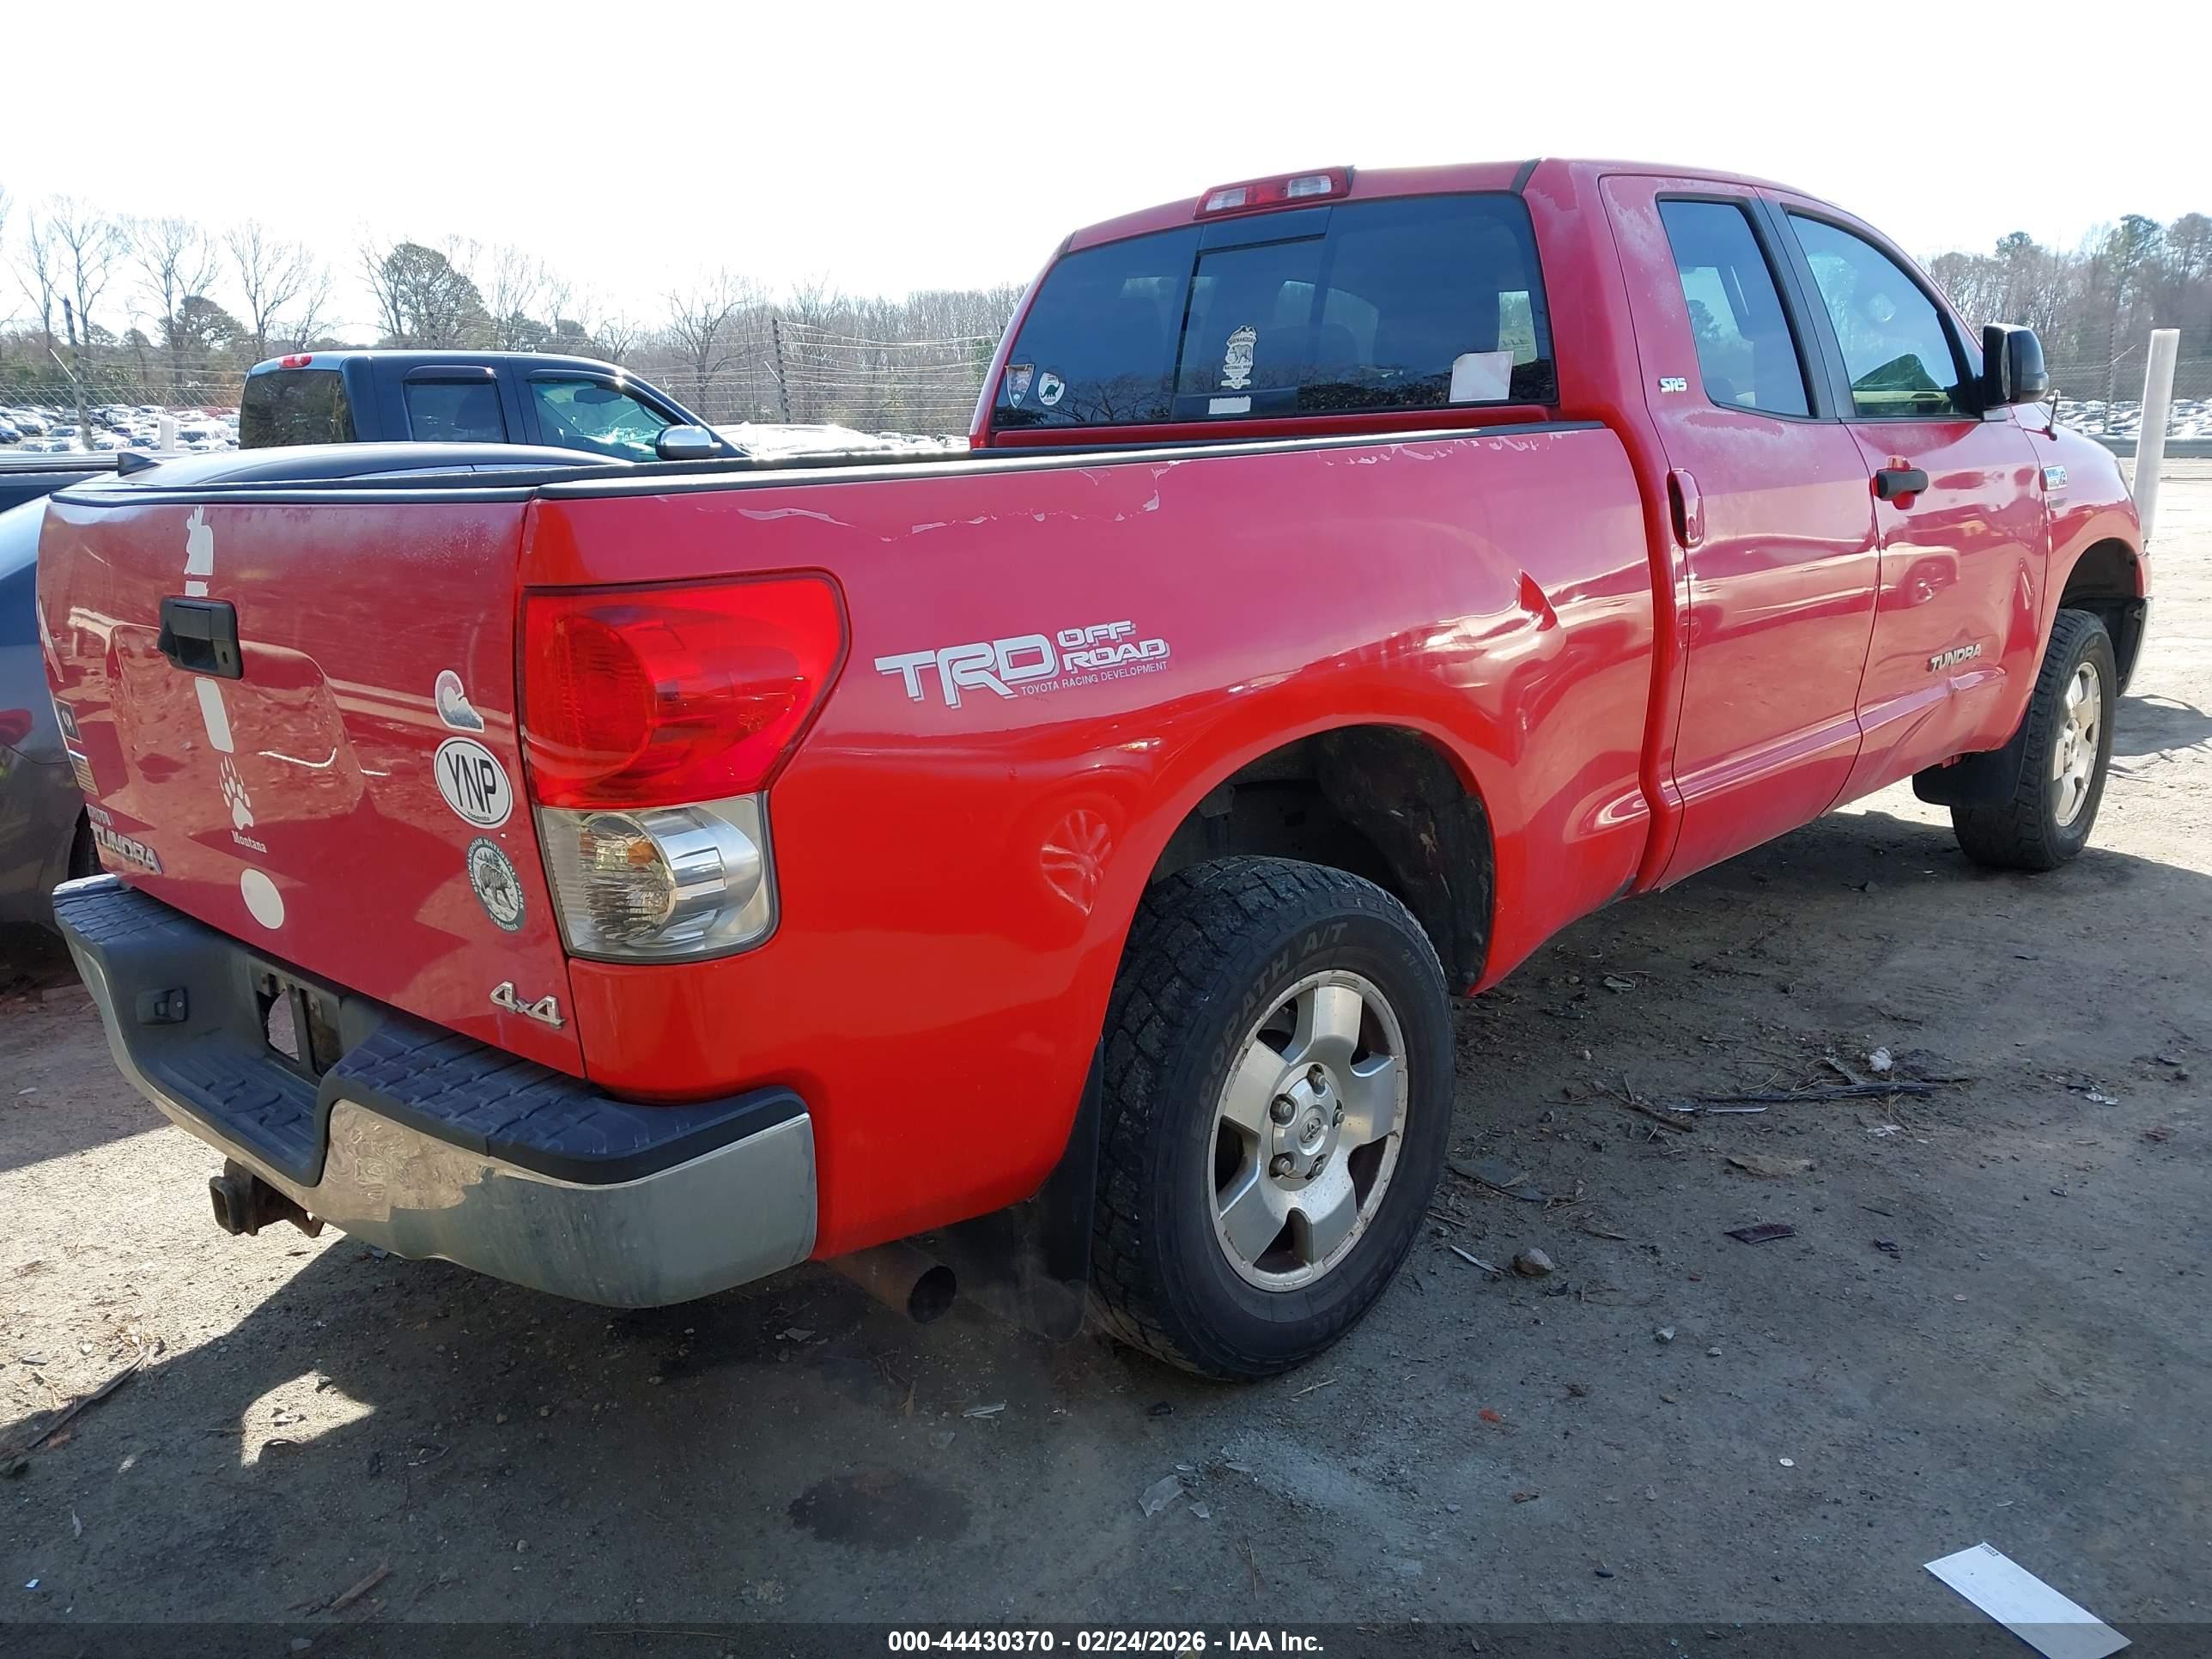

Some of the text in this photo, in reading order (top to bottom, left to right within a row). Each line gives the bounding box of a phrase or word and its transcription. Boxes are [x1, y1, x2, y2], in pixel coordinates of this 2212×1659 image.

[1660, 377, 1687, 392] SR5
[1057, 620, 1135, 648] OFF
[874, 634, 1060, 709] TRD
[1063, 638, 1170, 672] ROAD
[1930, 643, 1982, 673] TUNDRA
[1020, 660, 1168, 696] TOYOTA RACING DEVELOPMENT
[445, 751, 496, 814] YNP
[90, 821, 163, 874] TUNDRA
[231, 830, 269, 854] Montana
[489, 913, 519, 932] VIRGINIA
[1304, 922, 1347, 956] A/T
[489, 981, 567, 1030] 4x4
